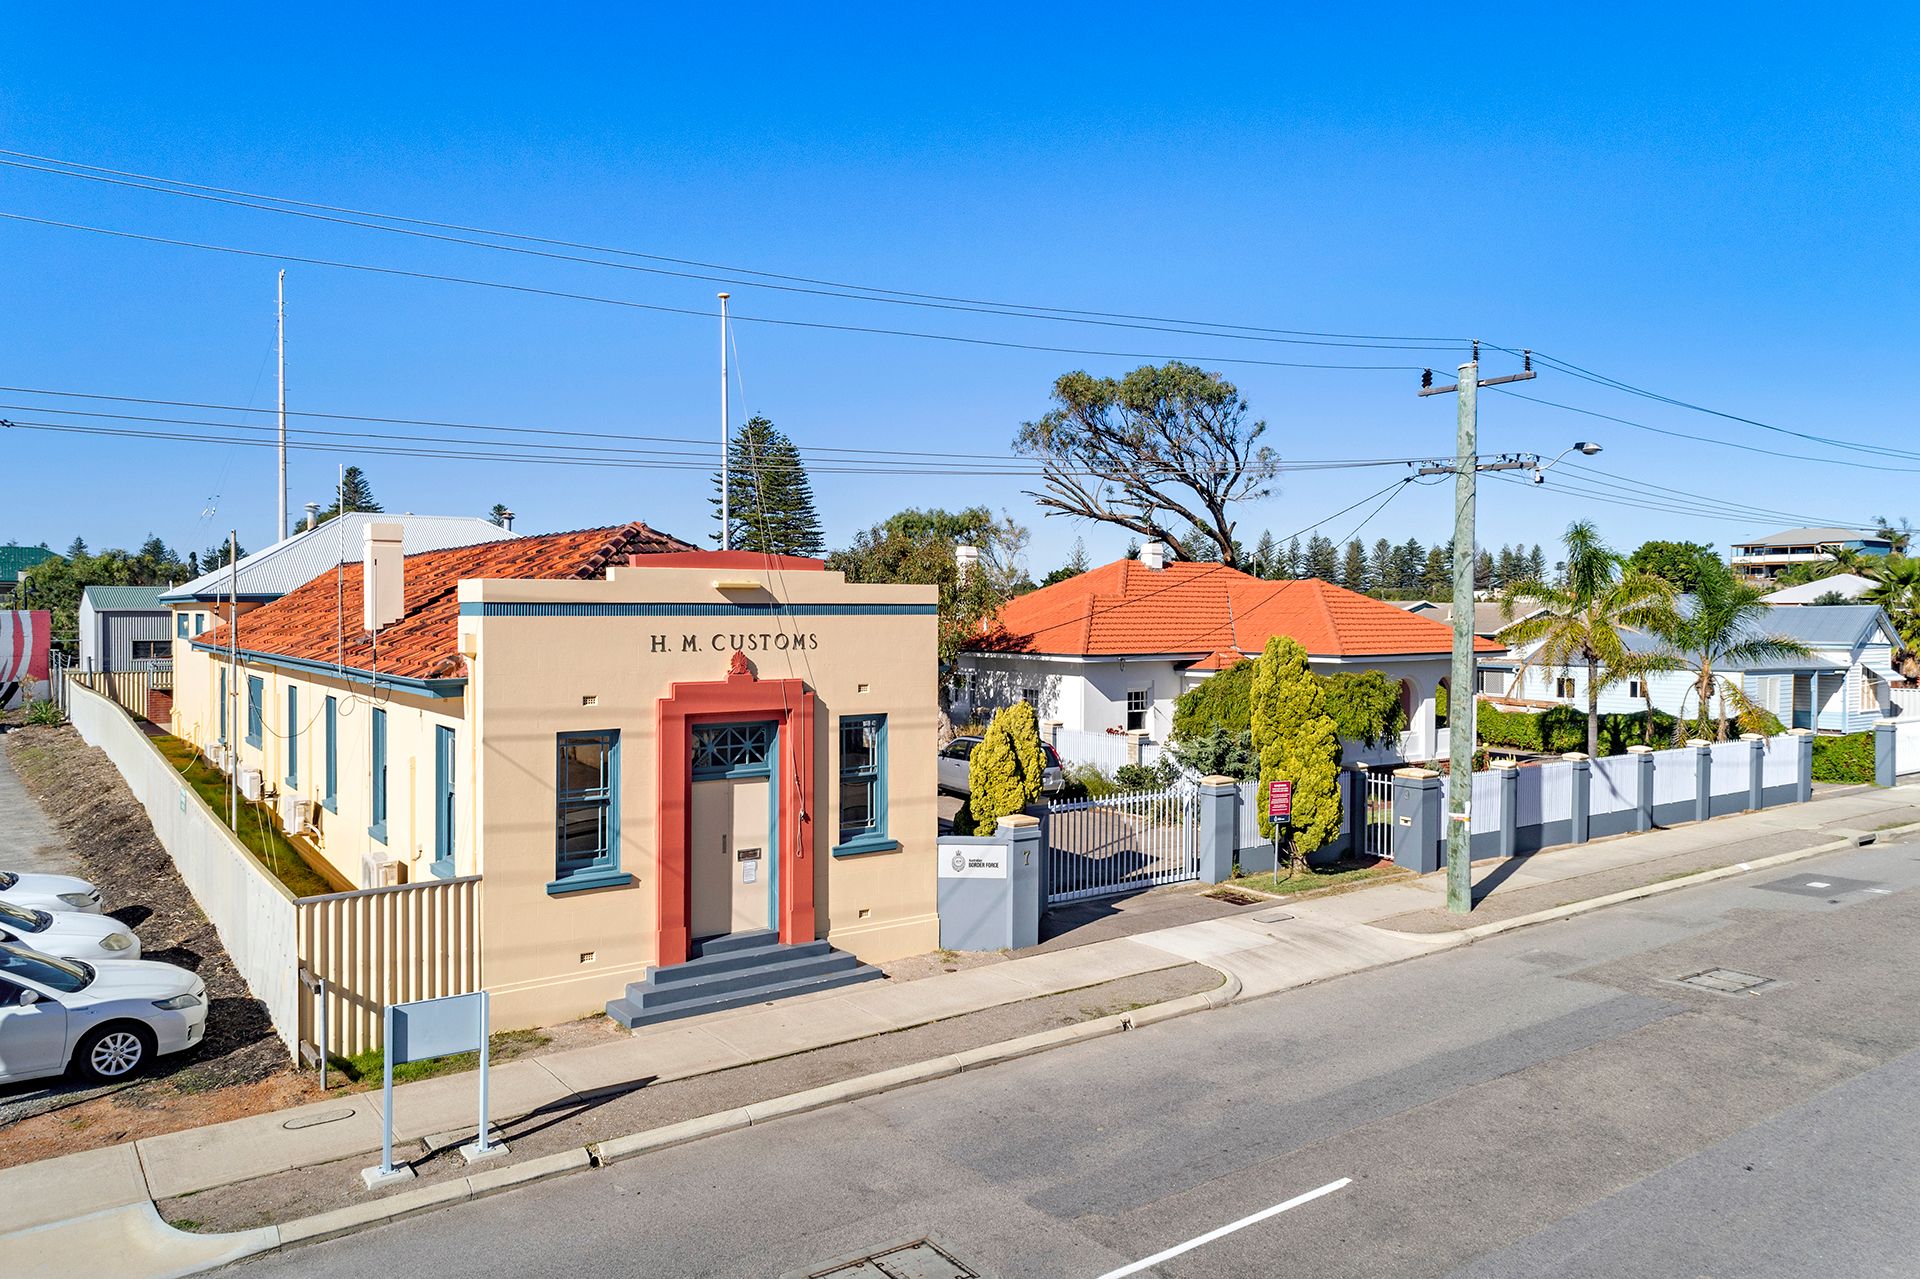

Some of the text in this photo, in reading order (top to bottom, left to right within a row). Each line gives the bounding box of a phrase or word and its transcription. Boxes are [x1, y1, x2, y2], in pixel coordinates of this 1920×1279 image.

[650, 633, 818, 652] H. M. CUSTOMS
[1023, 850, 1031, 866] 7
